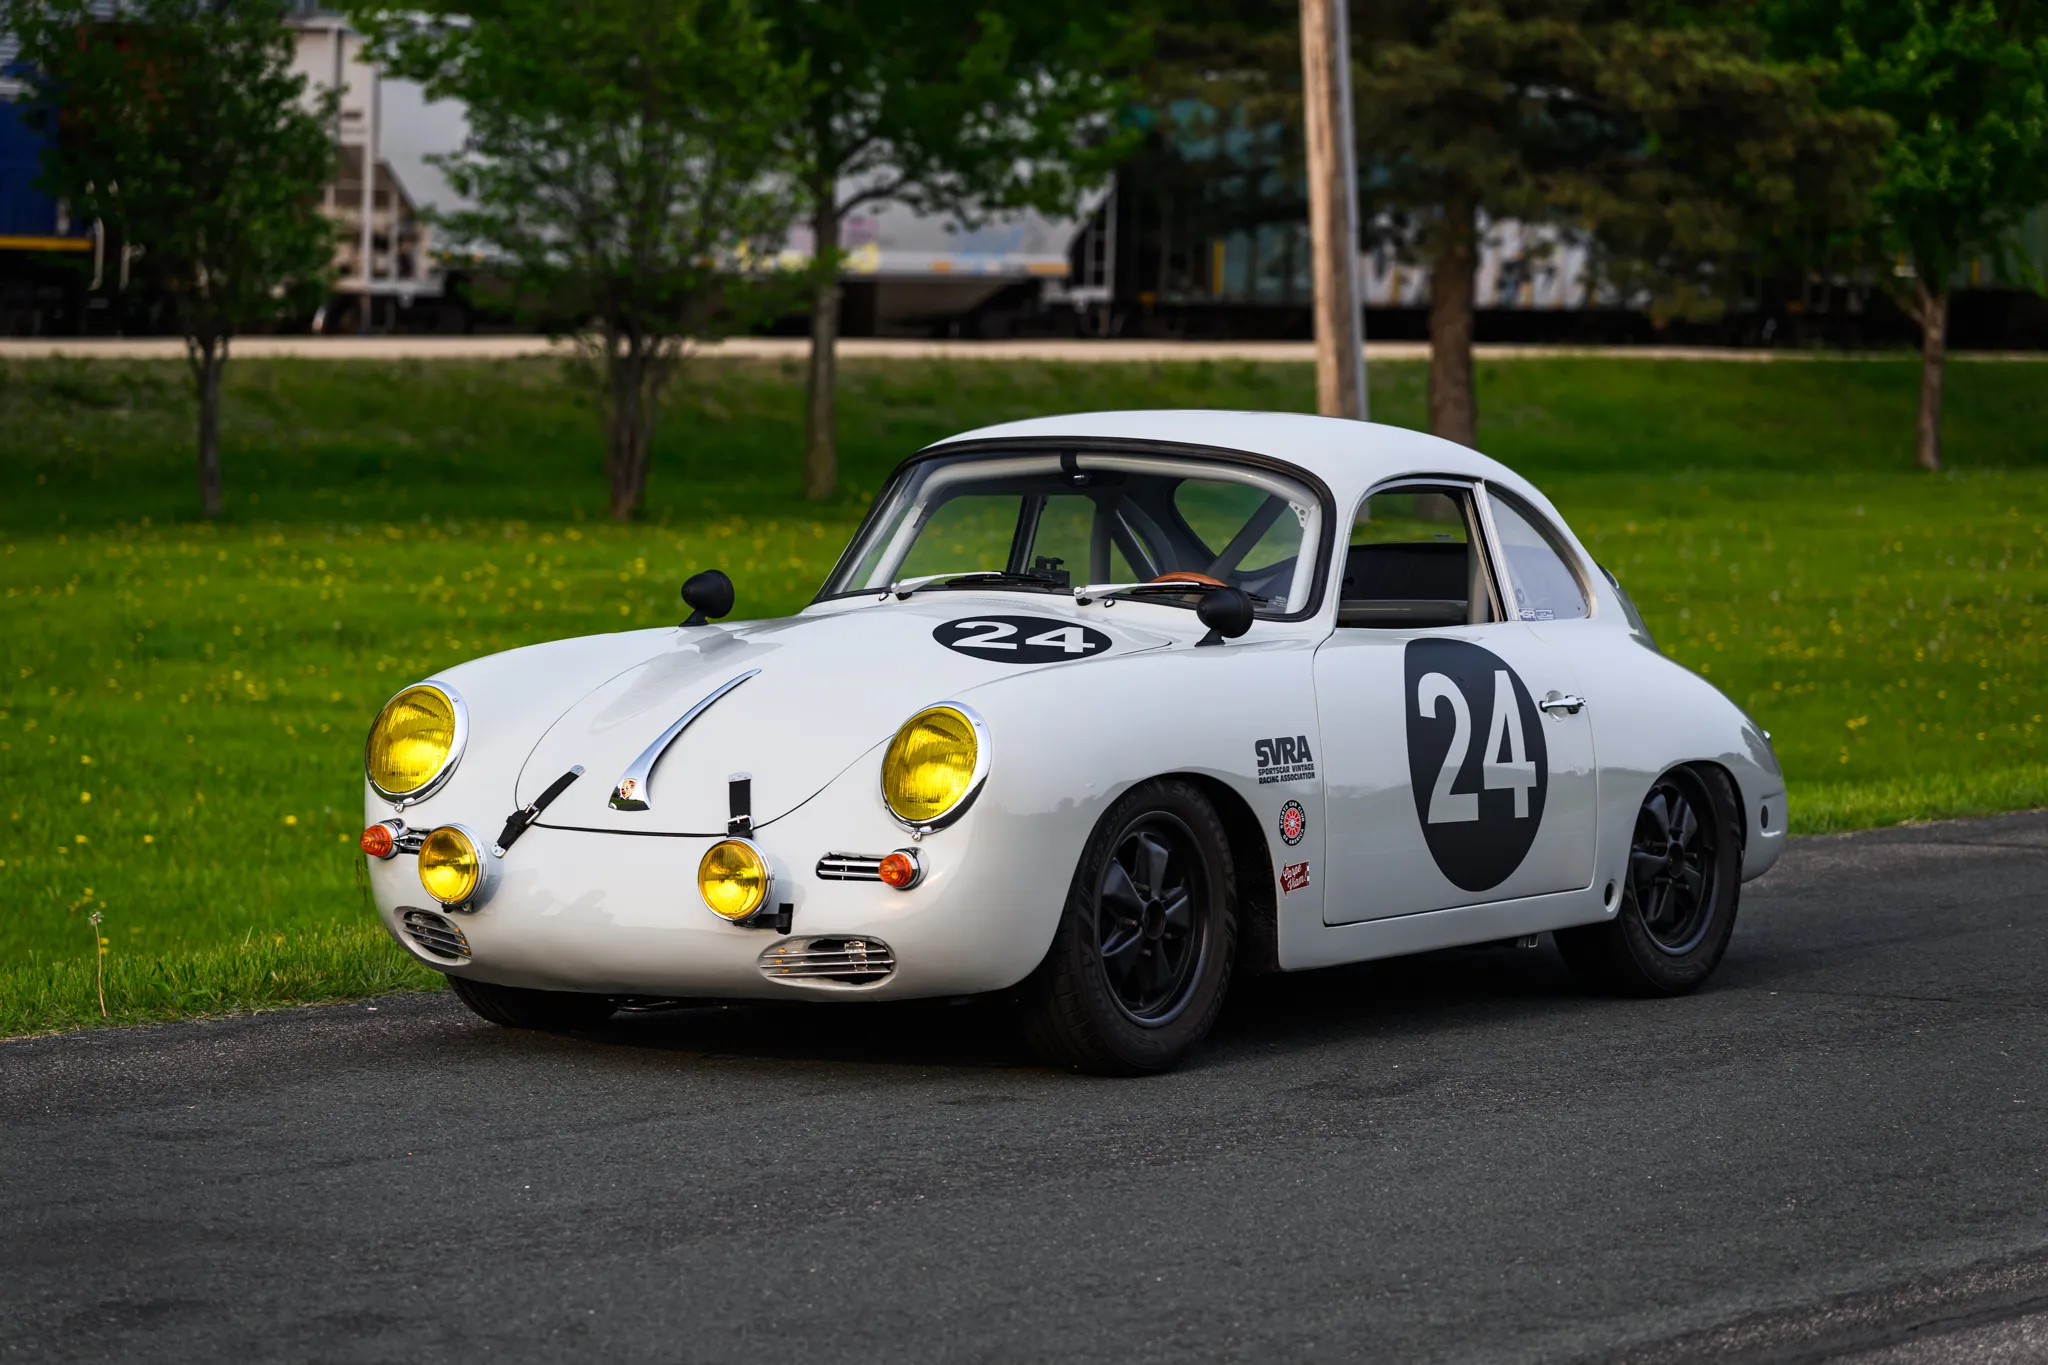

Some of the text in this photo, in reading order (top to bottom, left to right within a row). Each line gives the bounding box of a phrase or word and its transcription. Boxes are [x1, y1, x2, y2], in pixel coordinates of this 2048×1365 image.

[952, 621, 1095, 653] 24
[1255, 735, 1312, 766] SVRA
[1418, 669, 1537, 824] 24
[1258, 763, 1315, 776] SPORTSCAR VINTAGE
[1259, 771, 1316, 785] RACING ASSOCIATION
[1297, 806, 1305, 822] CLUB
[1288, 828, 1304, 844] AMERICA
